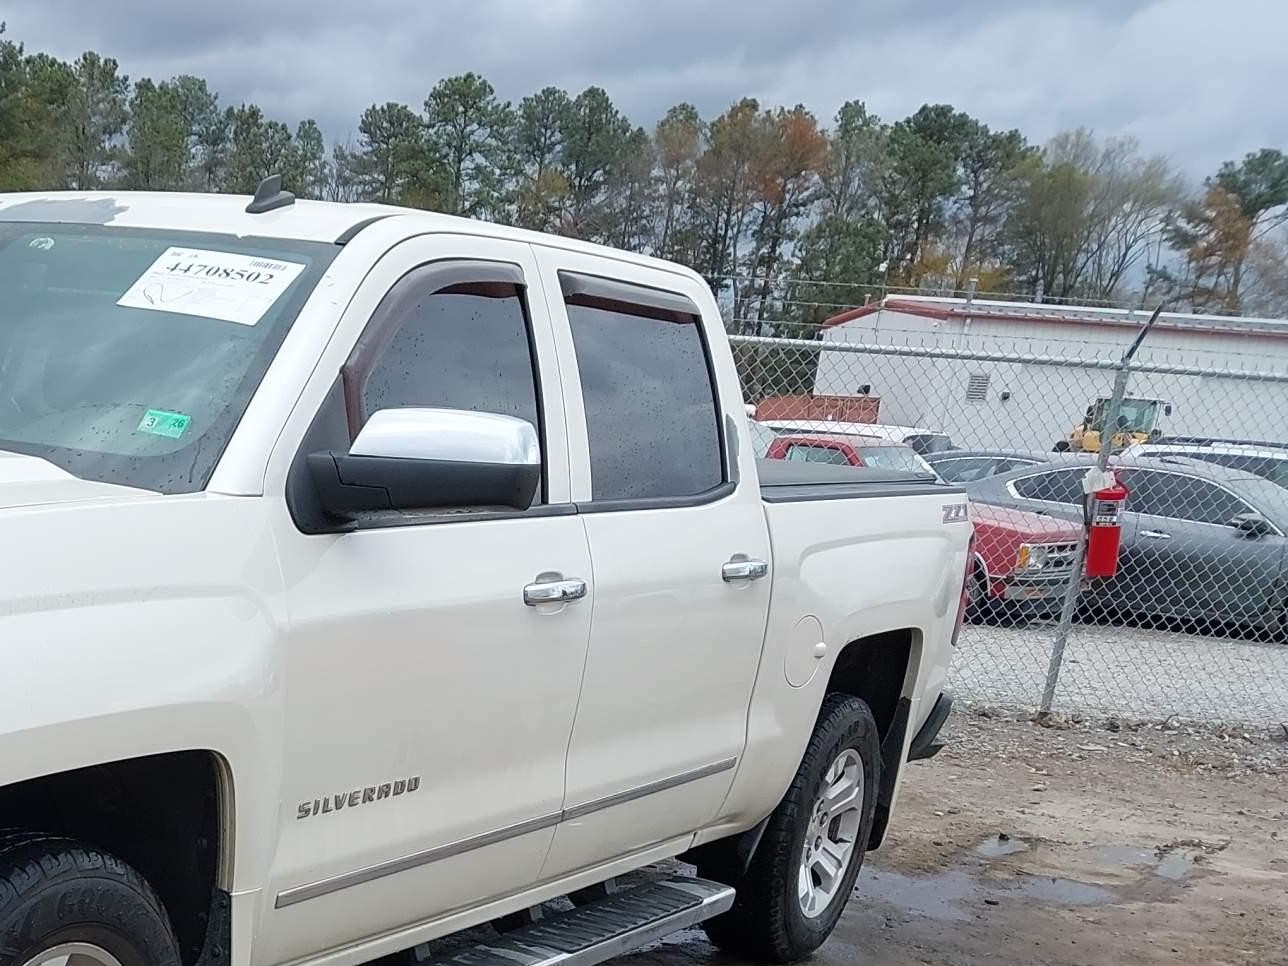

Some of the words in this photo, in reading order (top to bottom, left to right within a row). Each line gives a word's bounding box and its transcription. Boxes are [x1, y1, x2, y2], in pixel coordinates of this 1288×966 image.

[166, 261, 275, 285] 44708502
[146, 417, 156, 427] 3
[171, 418, 186, 428] 26
[296, 776, 421, 820] SILVERADO
